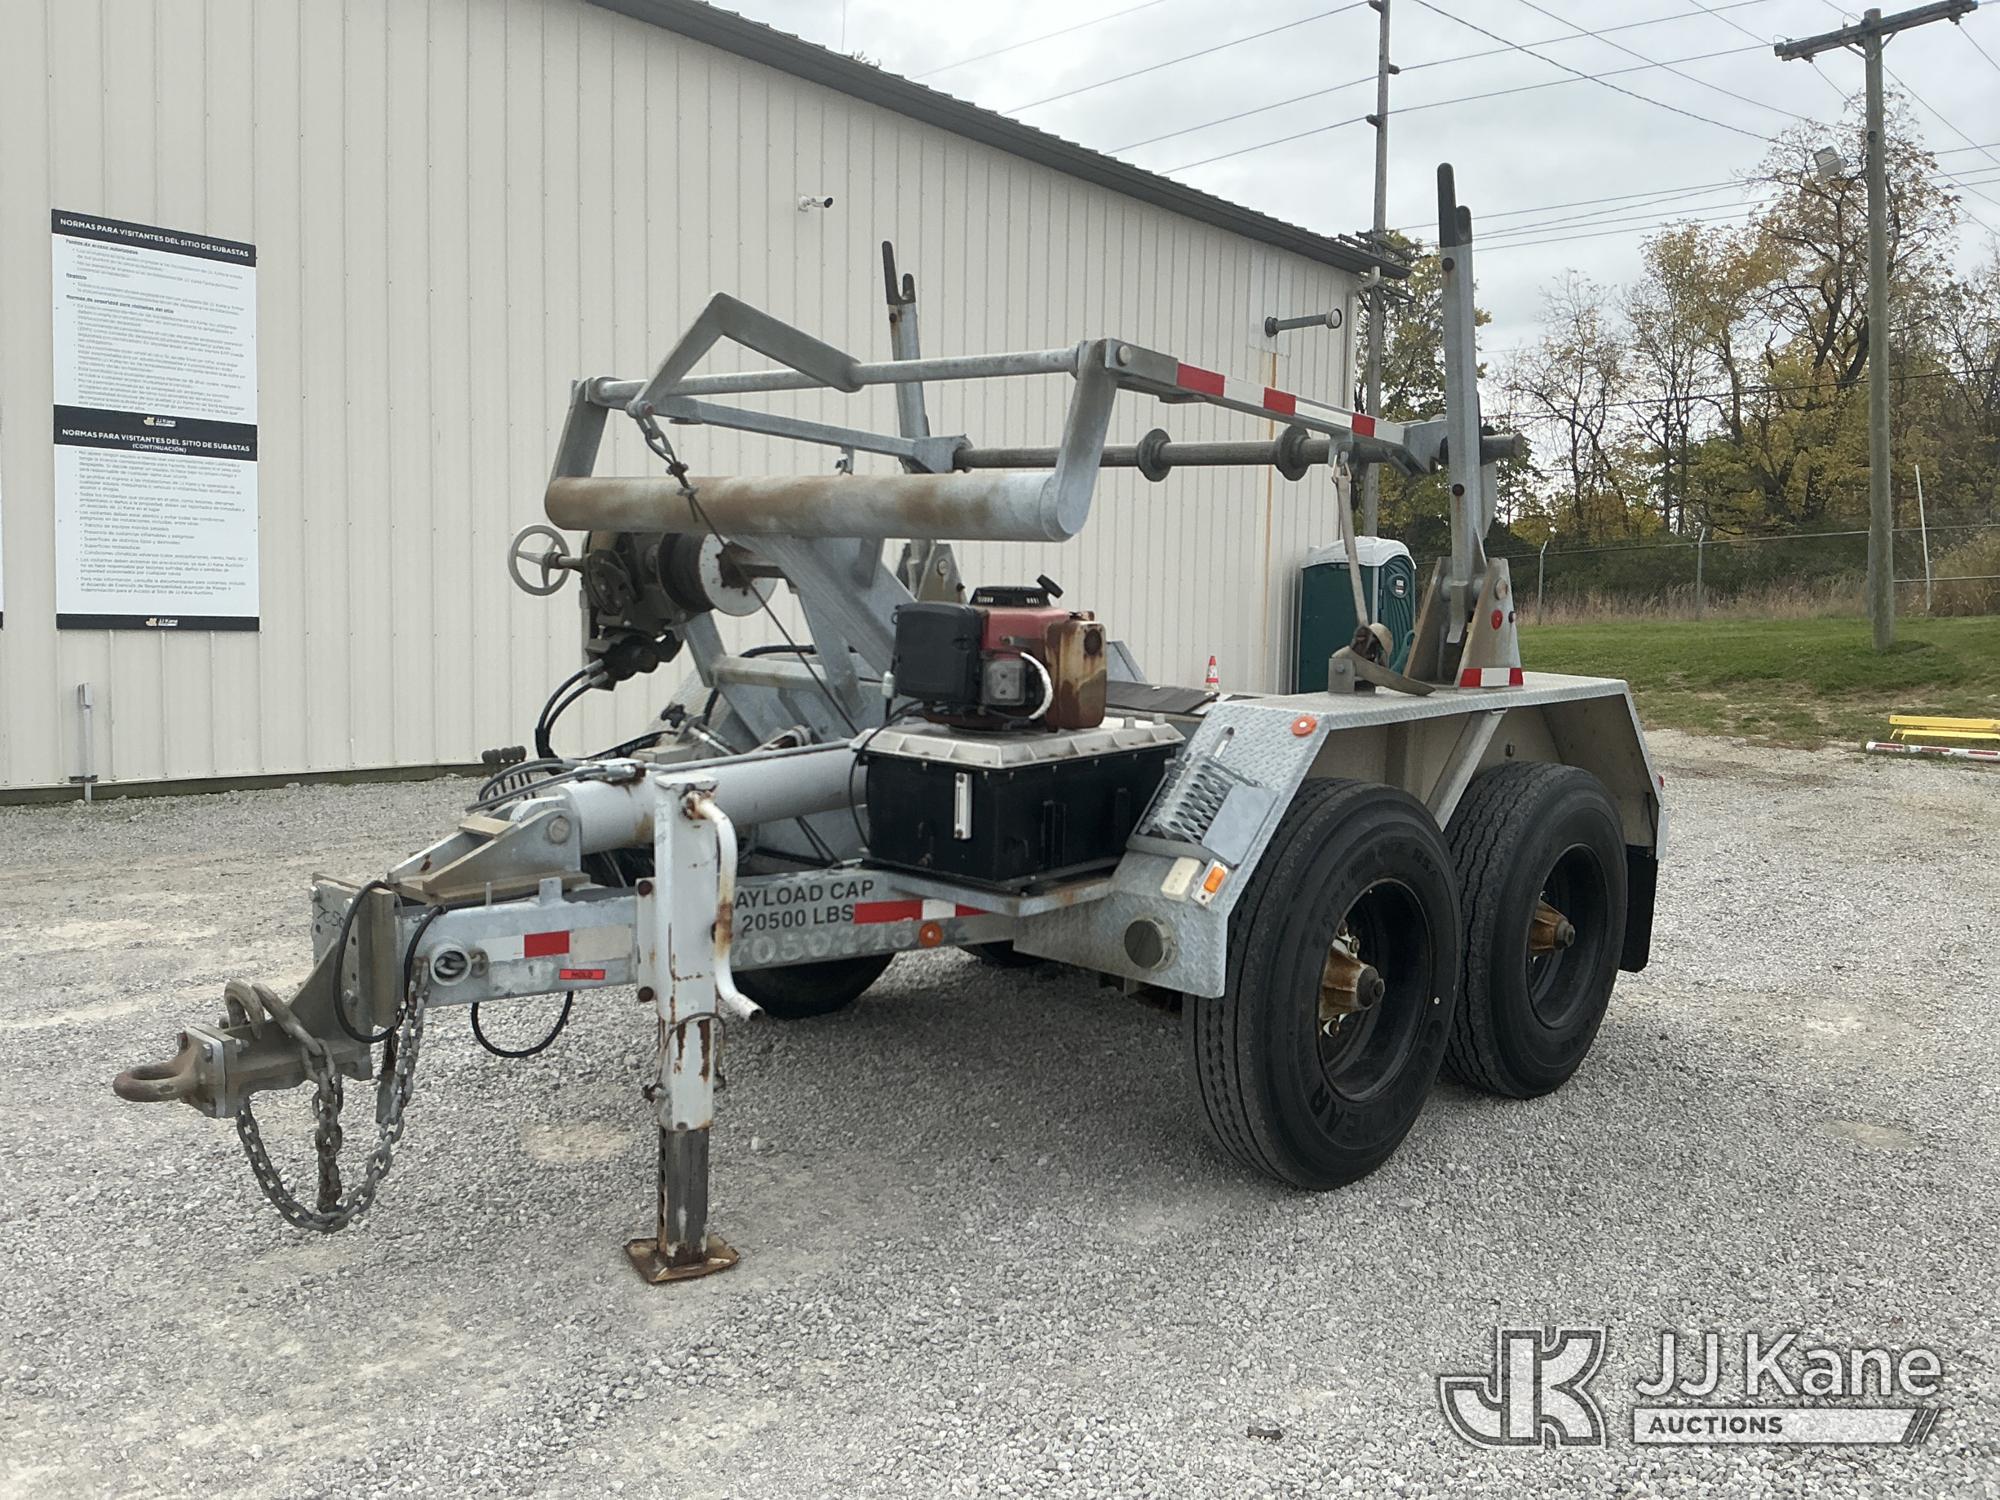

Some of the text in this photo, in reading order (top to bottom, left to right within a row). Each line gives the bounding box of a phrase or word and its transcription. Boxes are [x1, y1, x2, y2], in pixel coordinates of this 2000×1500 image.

[60, 218, 249, 257] NORMAS PARA VISITANTES DEL SITIO DE SUBASTAS
[62, 428, 250, 452] NORMAS PARA VISITANTES DEL SITIO DE SUBASTAS
[132, 443, 187, 454] (CONTINUACIÓN)
[735, 879, 874, 909] AYLOAD CAP
[742, 904, 854, 932] 20500 LBS
